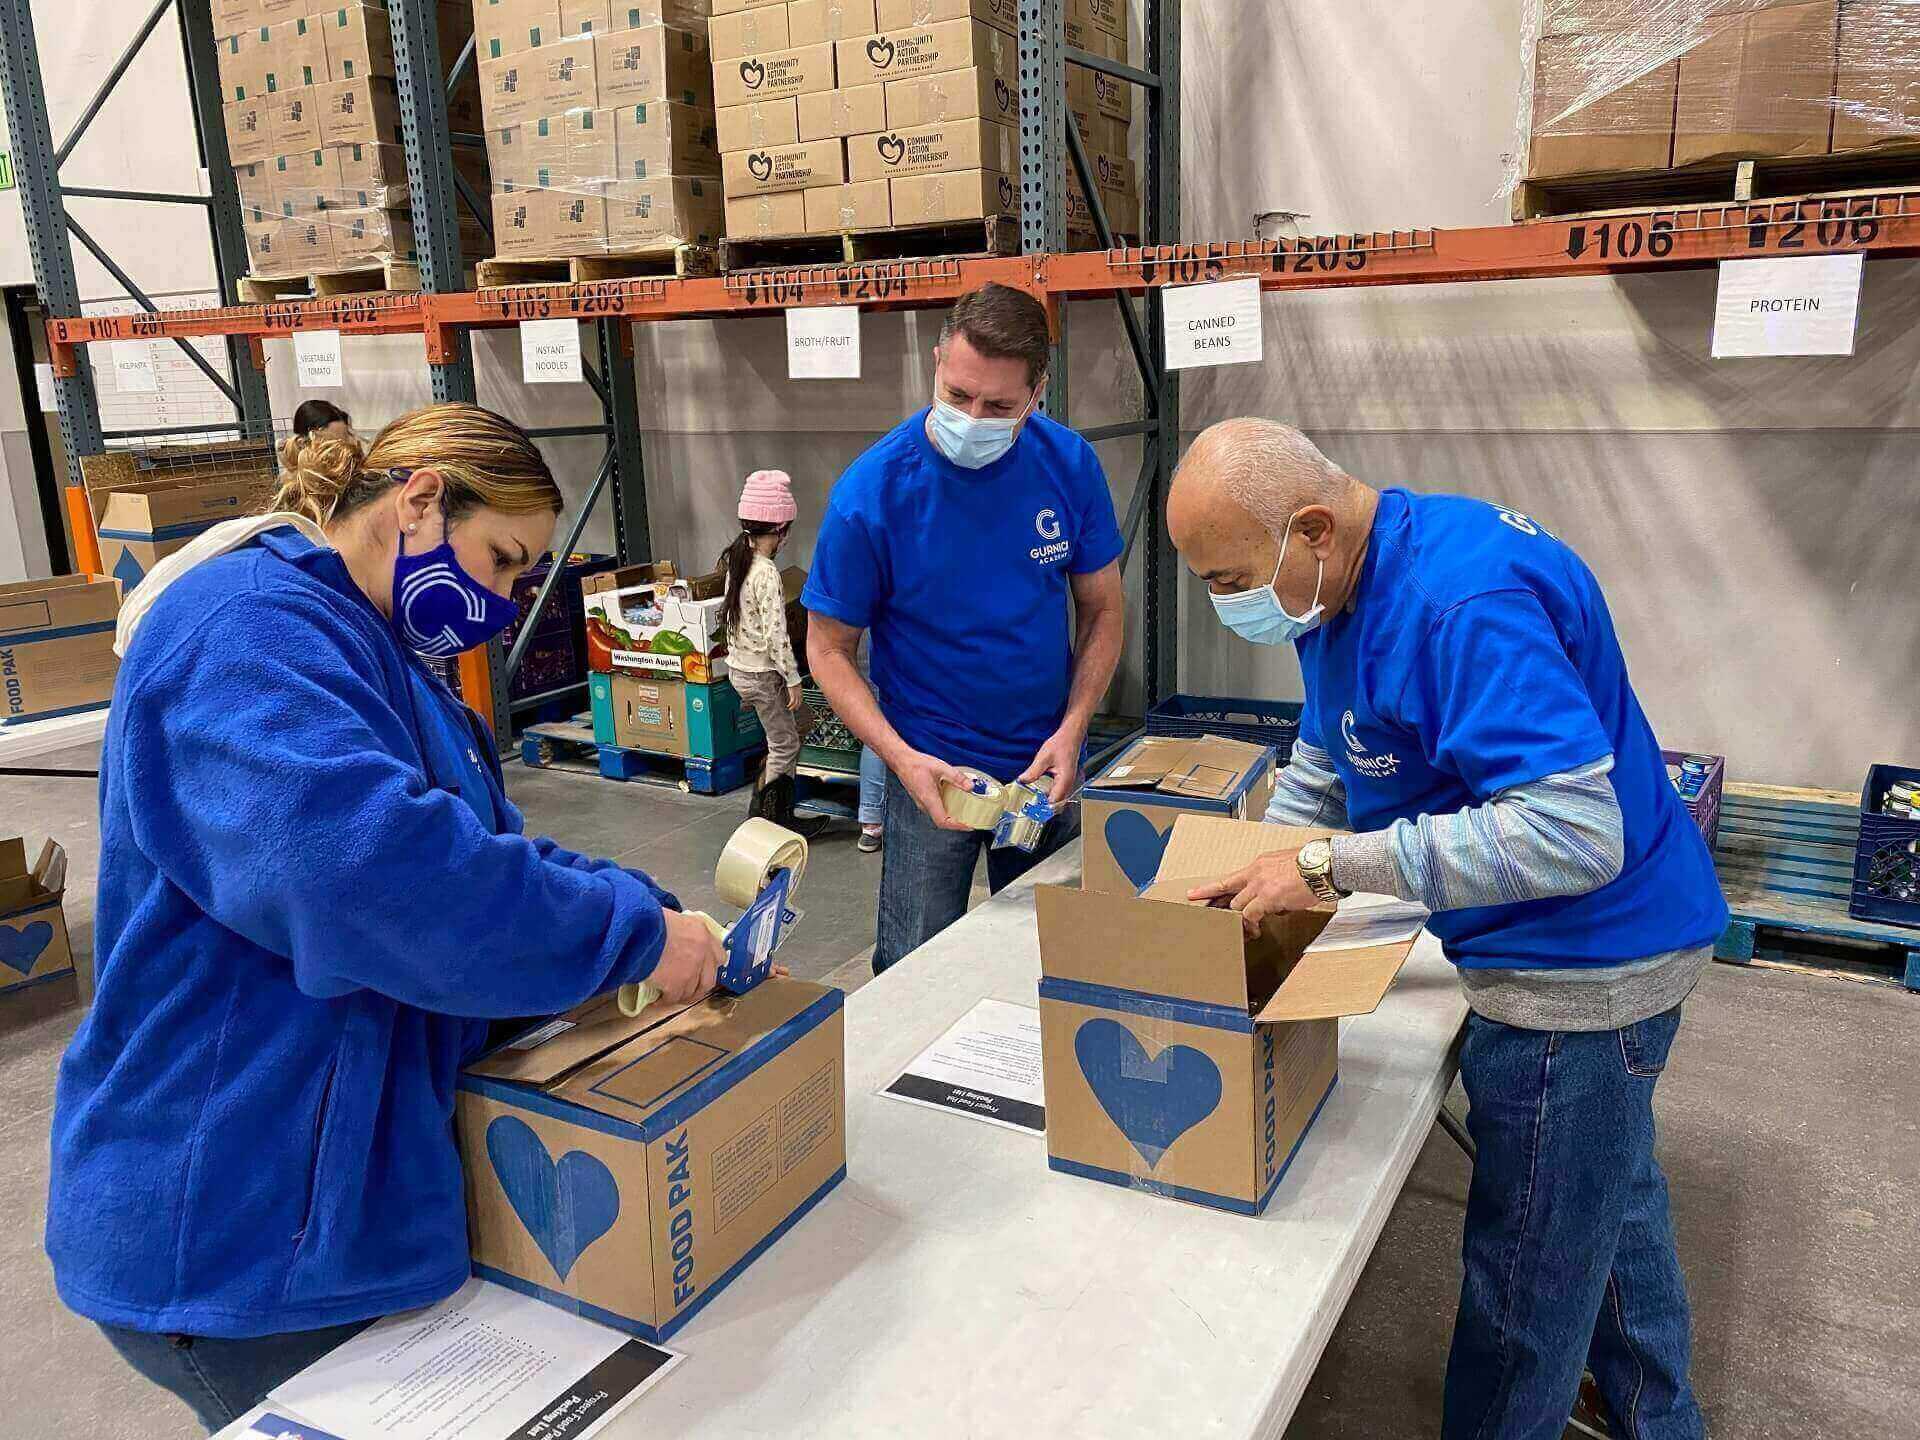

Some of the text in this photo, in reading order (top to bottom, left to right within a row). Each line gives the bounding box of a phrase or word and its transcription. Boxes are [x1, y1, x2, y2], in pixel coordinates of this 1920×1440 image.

[896, 46, 919, 58] ACTION
[897, 52, 939, 67] PARTNERSHIP
[766, 58, 800, 71] COMMUNITY
[767, 69, 787, 79] ACTION
[767, 75, 804, 88] PARTNERSHIP
[906, 133, 944, 146] COMMUNITY
[774, 151, 807, 163] COMMUNITY
[907, 145, 930, 155] ACTION
[907, 151, 949, 165] PARTNERSHIP
[775, 162, 795, 171] ACTION
[775, 168, 812, 180] PARTNERSHIP
[1592, 205, 1880, 259] 106 206
[1165, 237, 1367, 283] 105 205
[761, 264, 909, 305] 104 204
[515, 285, 625, 318] 103 203
[1750, 298, 1821, 313] PROTEIN
[99, 319, 121, 338] 101
[141, 315, 166, 336] 201
[275, 305, 304, 329] 102
[342, 300, 378, 324] 202
[1188, 315, 1236, 331] CANNED
[794, 336, 851, 347] BROTH/FRUIT
[1194, 335, 1231, 350] BEANS
[535, 345, 566, 355] INSTANT
[308, 367, 332, 376] TOMATO
[535, 361, 568, 370] NOODLES
[613, 652, 680, 667] Washington Apples
[0, 648, 25, 714] FOOD PAK
[1263, 1023, 1276, 1185] FOOD PAK
[664, 1127, 696, 1308] FOOD PAK
[577, 1390, 609, 1414] Project
[526, 1394, 582, 1438] Packing List
[559, 1411, 581, 1432] Food
